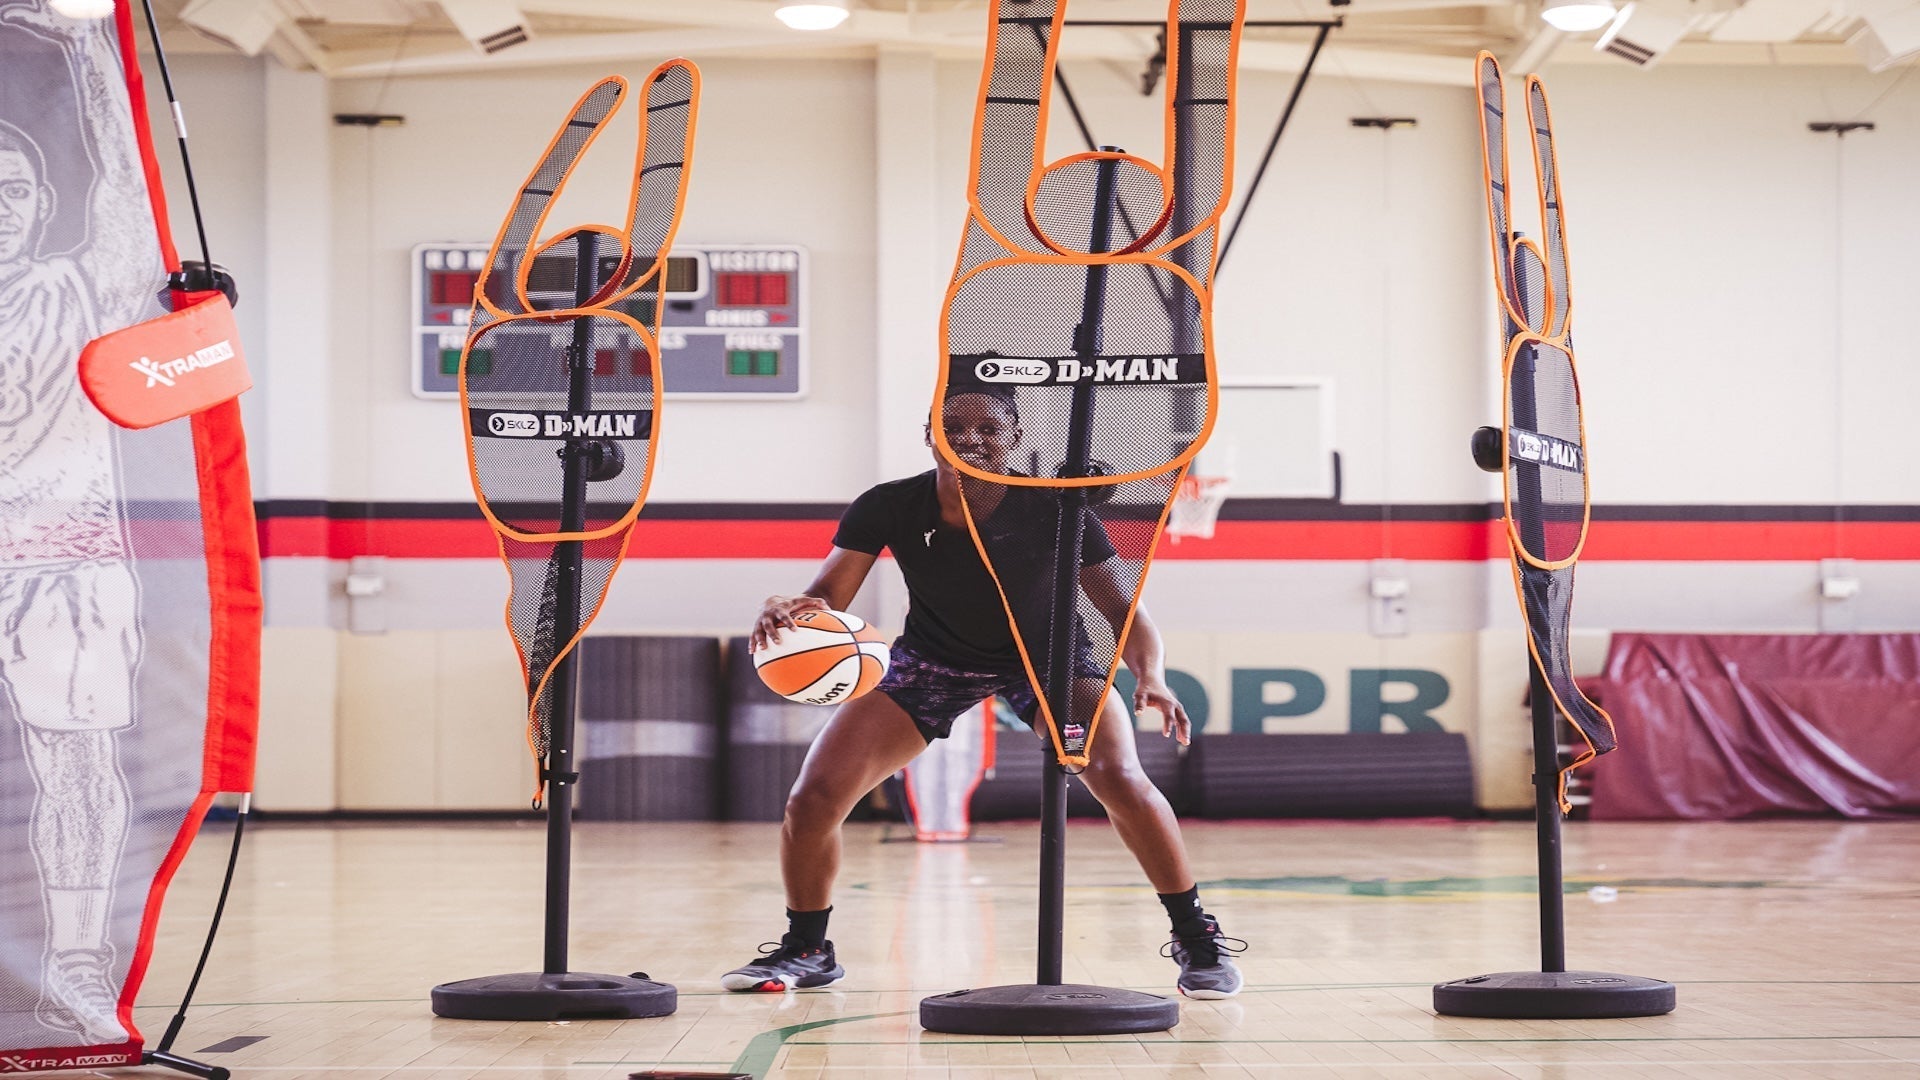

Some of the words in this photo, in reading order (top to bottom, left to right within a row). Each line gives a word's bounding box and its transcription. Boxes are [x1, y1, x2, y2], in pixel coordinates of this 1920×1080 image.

[709, 251, 797, 271] VISITOR
[1002, 365, 1044, 376] SKLZ
[507, 420, 536, 430] SKLZ
